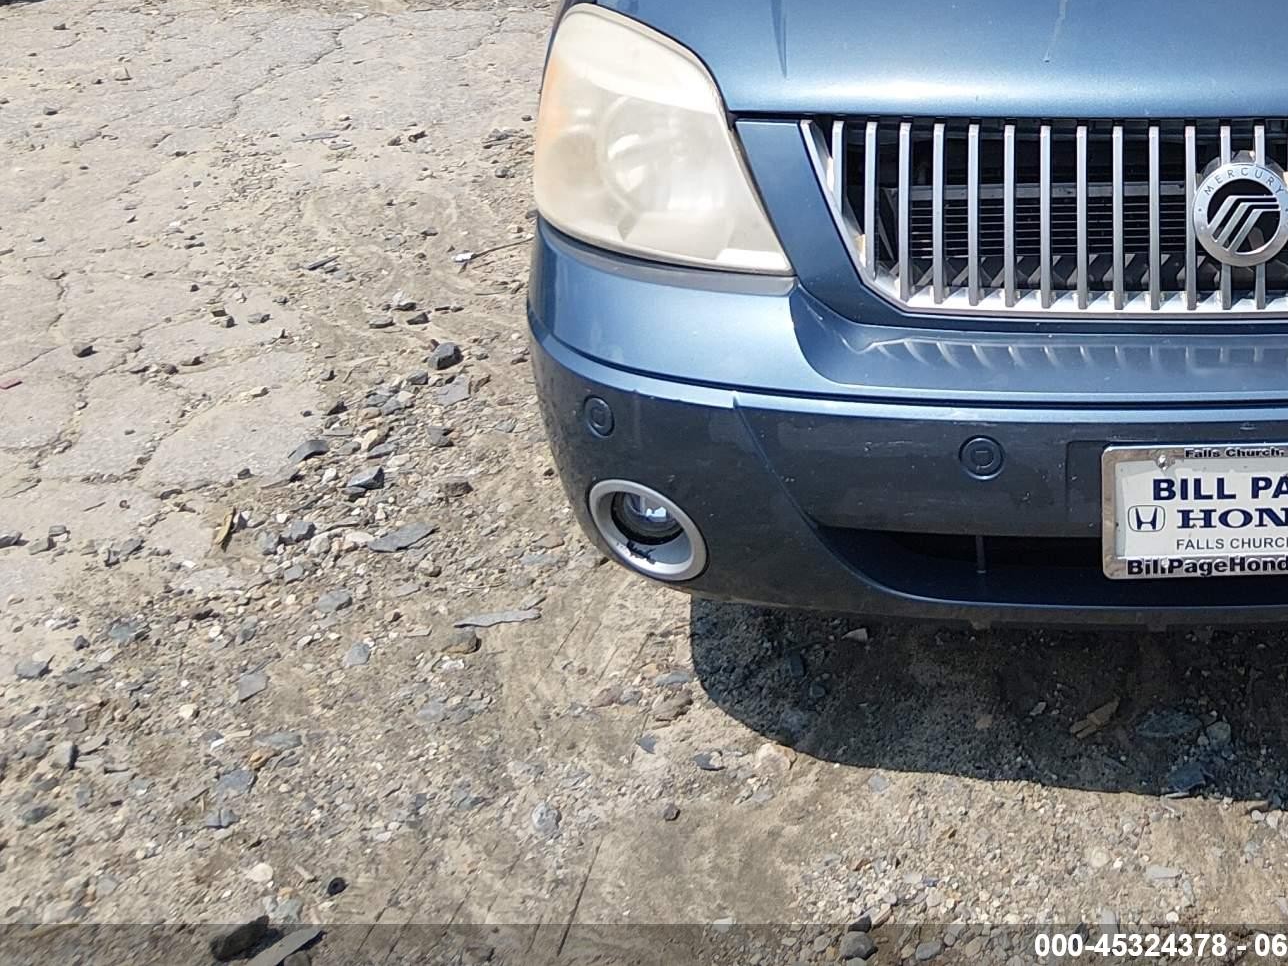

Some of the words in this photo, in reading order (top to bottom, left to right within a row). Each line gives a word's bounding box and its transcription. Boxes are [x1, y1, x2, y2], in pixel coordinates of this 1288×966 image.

[1204, 167, 1284, 196] MERCURY
[1185, 448, 1221, 458] Falls
[1225, 447, 1285, 457] Church,
[1153, 477, 1237, 501] BILL
[1176, 538, 1225, 551] FALLS
